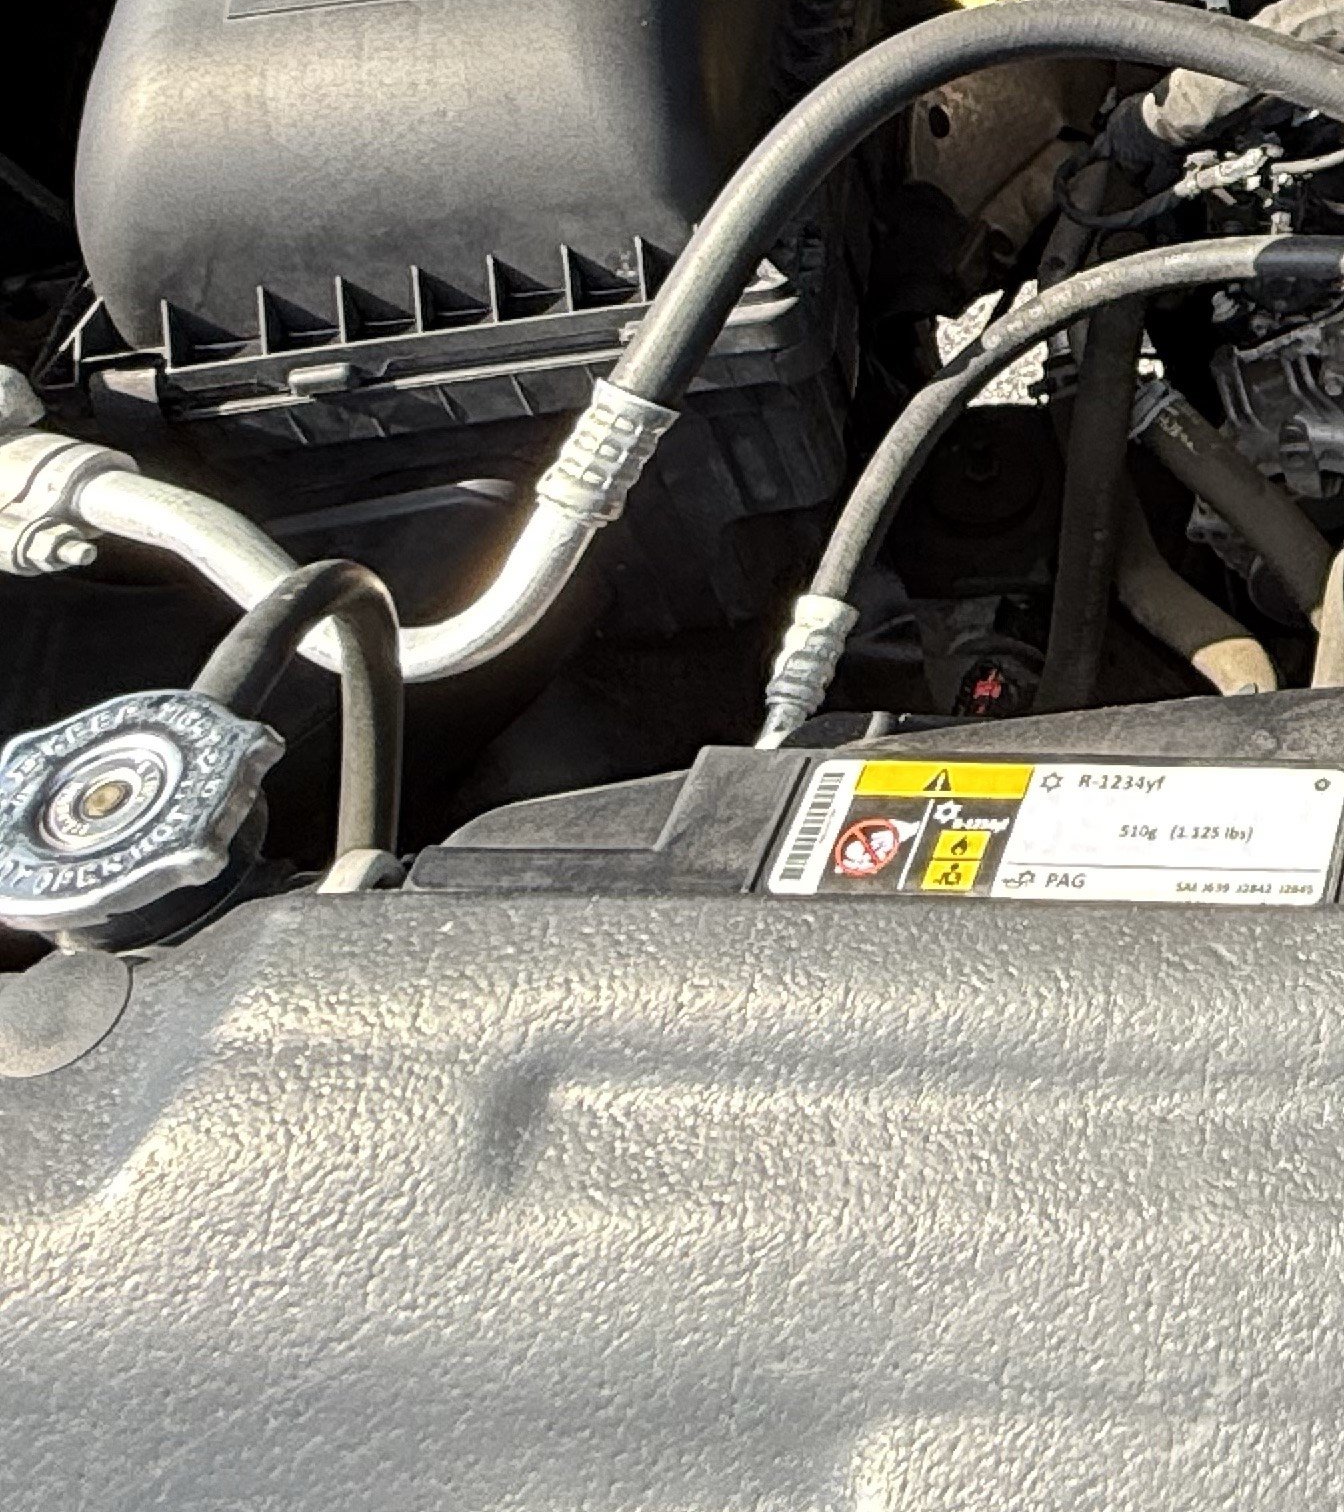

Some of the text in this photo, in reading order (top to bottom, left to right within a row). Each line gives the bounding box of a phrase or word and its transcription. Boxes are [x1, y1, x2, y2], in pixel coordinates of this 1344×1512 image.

[1079, 774, 1166, 794] R-1234yf
[1118, 824, 1158, 842] 510g
[1224, 825, 1254, 843] lbs)
[1045, 872, 1087, 889] PAG
